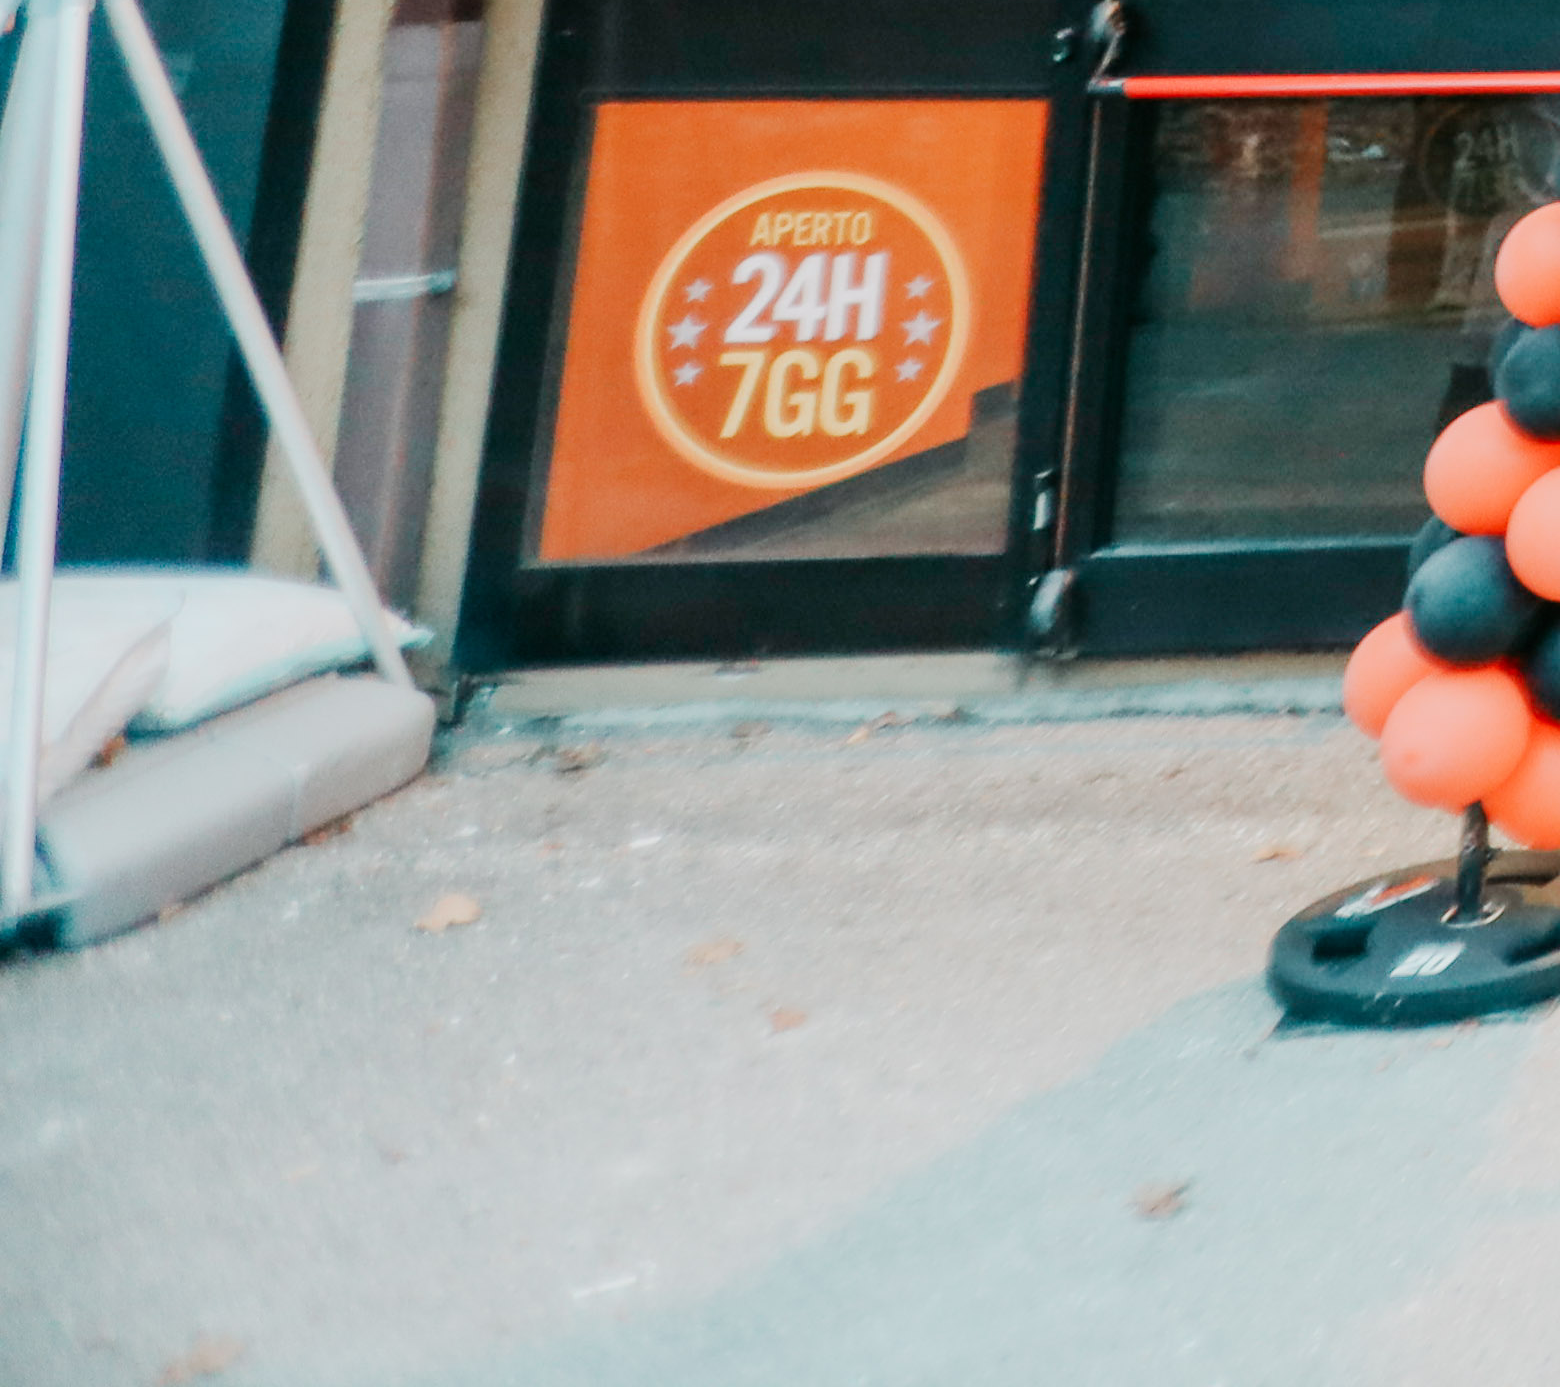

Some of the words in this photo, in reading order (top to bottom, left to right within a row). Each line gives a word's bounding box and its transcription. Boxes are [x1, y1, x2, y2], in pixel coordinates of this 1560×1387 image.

[748, 211, 874, 247] APERTO
[723, 251, 889, 345] 24H
[718, 347, 877, 440] 7GG
